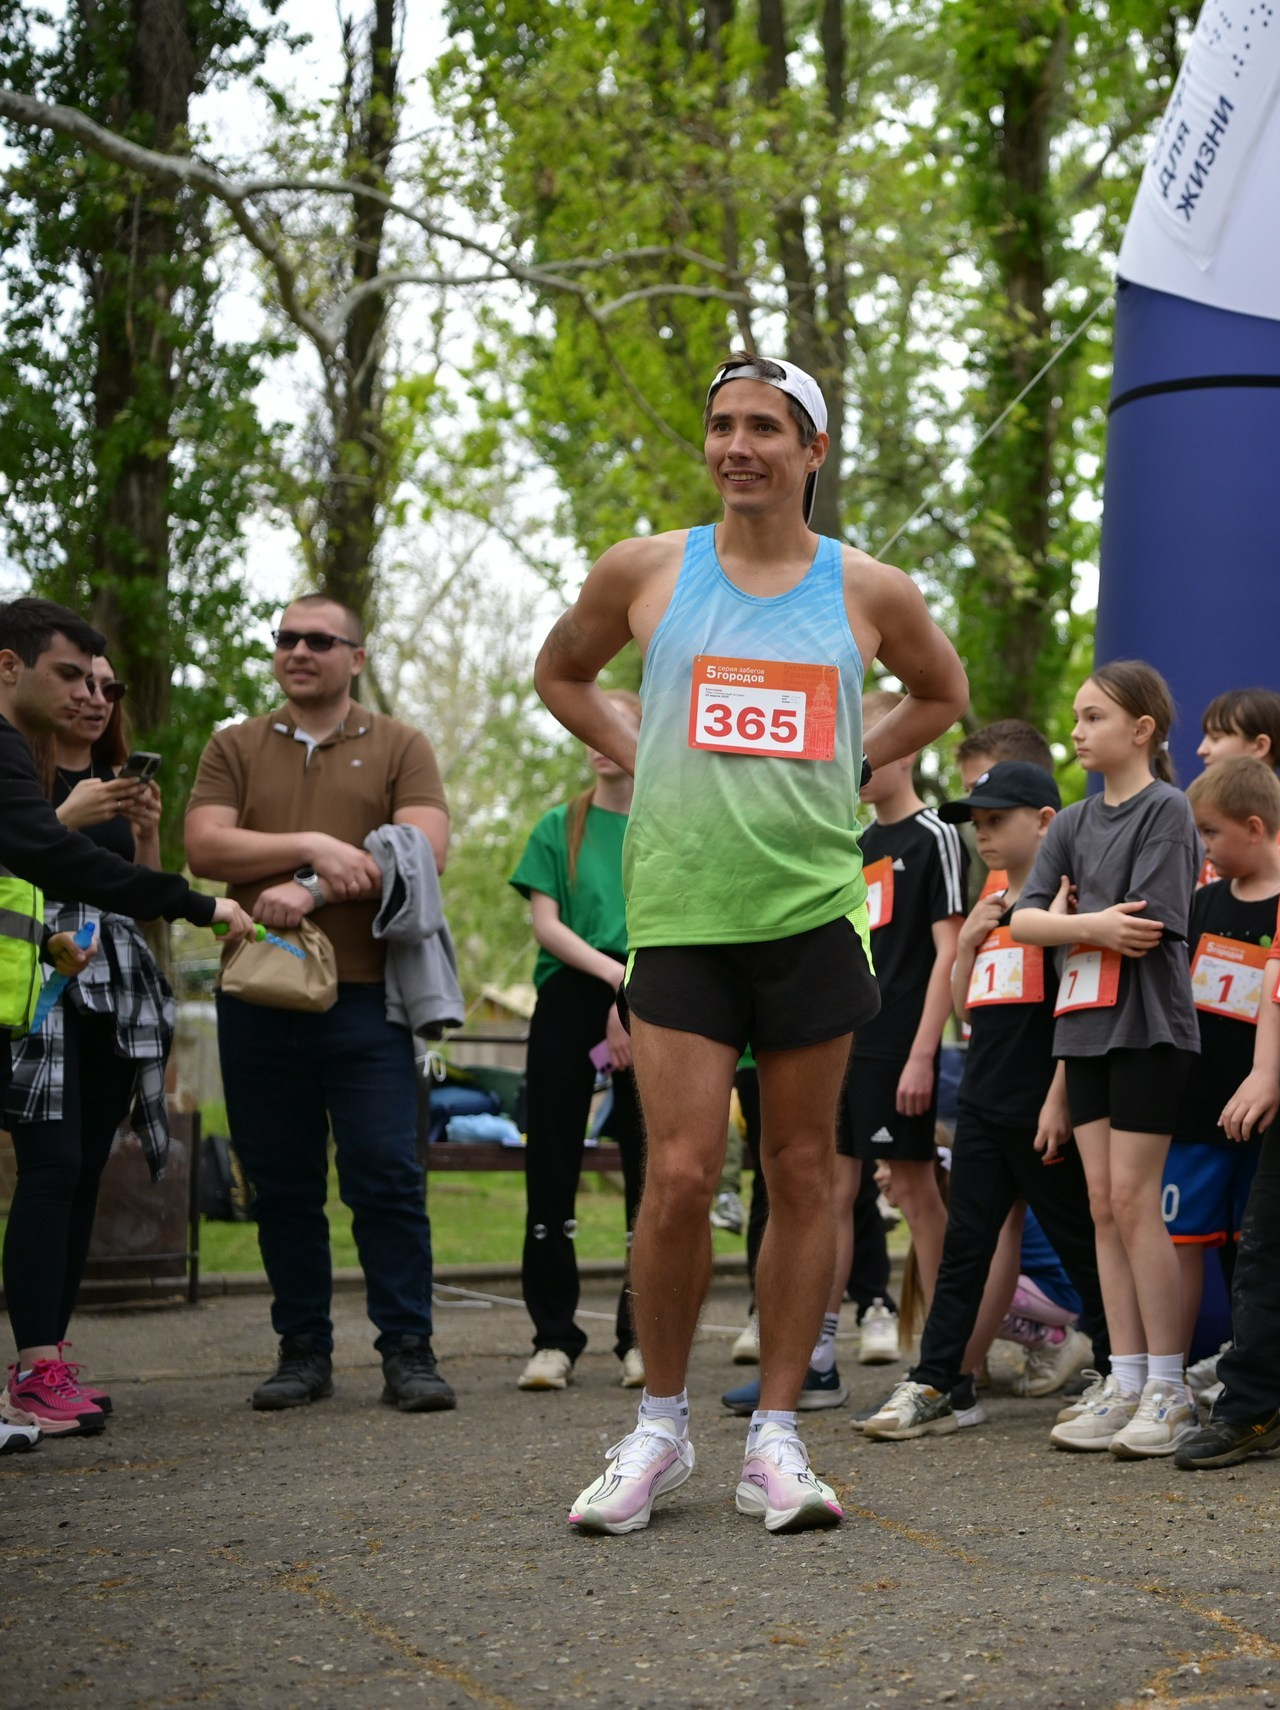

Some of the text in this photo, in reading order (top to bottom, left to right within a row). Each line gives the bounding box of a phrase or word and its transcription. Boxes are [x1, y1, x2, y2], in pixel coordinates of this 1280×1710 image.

[1159, 121, 1191, 199] ДЛЯ
[1176, 95, 1235, 222] ЖИЗНИ
[703, 703, 798, 743] 365
[985, 962, 995, 993] 1
[1218, 974, 1234, 1003] 1
